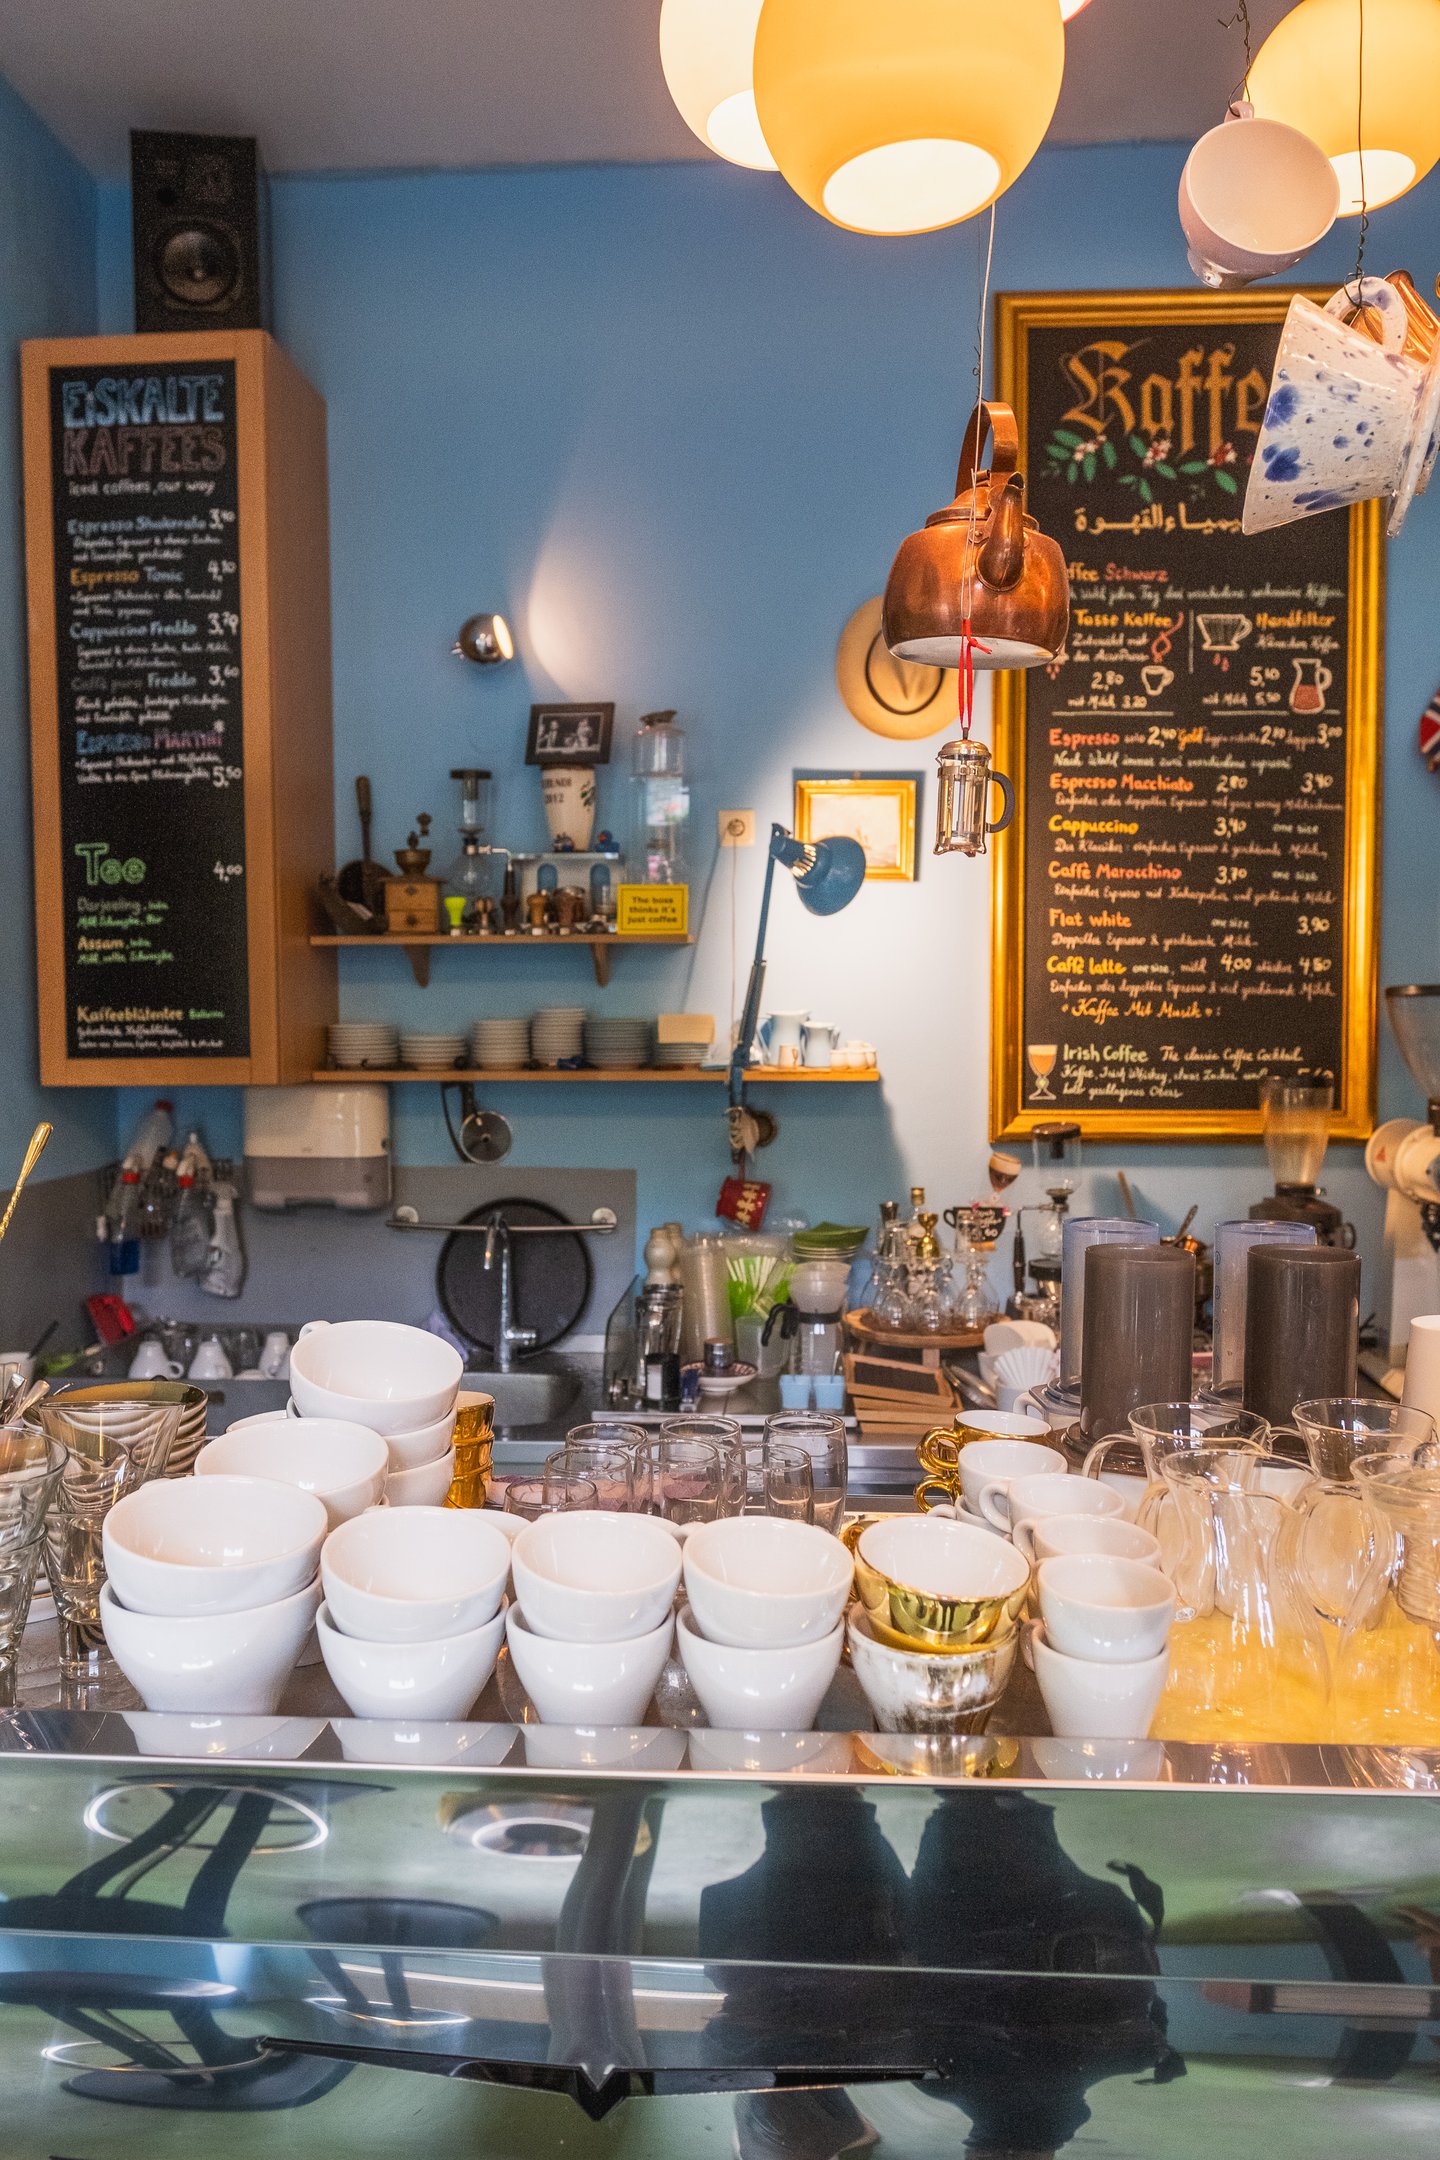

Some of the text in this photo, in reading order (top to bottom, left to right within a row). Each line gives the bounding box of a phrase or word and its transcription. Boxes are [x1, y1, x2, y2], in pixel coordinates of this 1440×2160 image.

[1059, 337, 1267, 460] Kaffe
[62, 427, 228, 476] KAFFEES
[185, 481, 215, 497] way
[67, 518, 133, 537] Espresso
[70, 565, 183, 590] Espresso Tonic
[1067, 561, 1168, 584] ffee Schwarz
[150, 619, 198, 636] Freddo
[1073, 608, 1172, 628] Tasse Kaffee
[1255, 609, 1336, 628] Handfilter
[147, 672, 197, 688] Freddo
[1049, 728, 1120, 751] Espresso
[1050, 773, 1118, 795] Espresso
[1121, 773, 1194, 792] Macchiato
[1048, 814, 1140, 839] Cappuccino
[75, 842, 147, 886] Tee
[1048, 861, 1091, 881] Caffè
[1095, 861, 1183, 881] Marocchino
[629, 906, 659, 914] thinks
[632, 896, 674, 904] The boss
[628, 916, 678, 925] just coffee
[1048, 908, 1084, 928] Flat
[1088, 909, 1133, 928] white
[1046, 955, 1086, 975] Caffè
[1088, 957, 1127, 975] latte
[1070, 997, 1203, 1025] Kaffee Mit Musik
[1062, 1043, 1101, 1062] Irish
[1102, 1044, 1148, 1063] Coffee
[1159, 1045, 1182, 1062] The
[1222, 1047, 1254, 1071] Coffee
